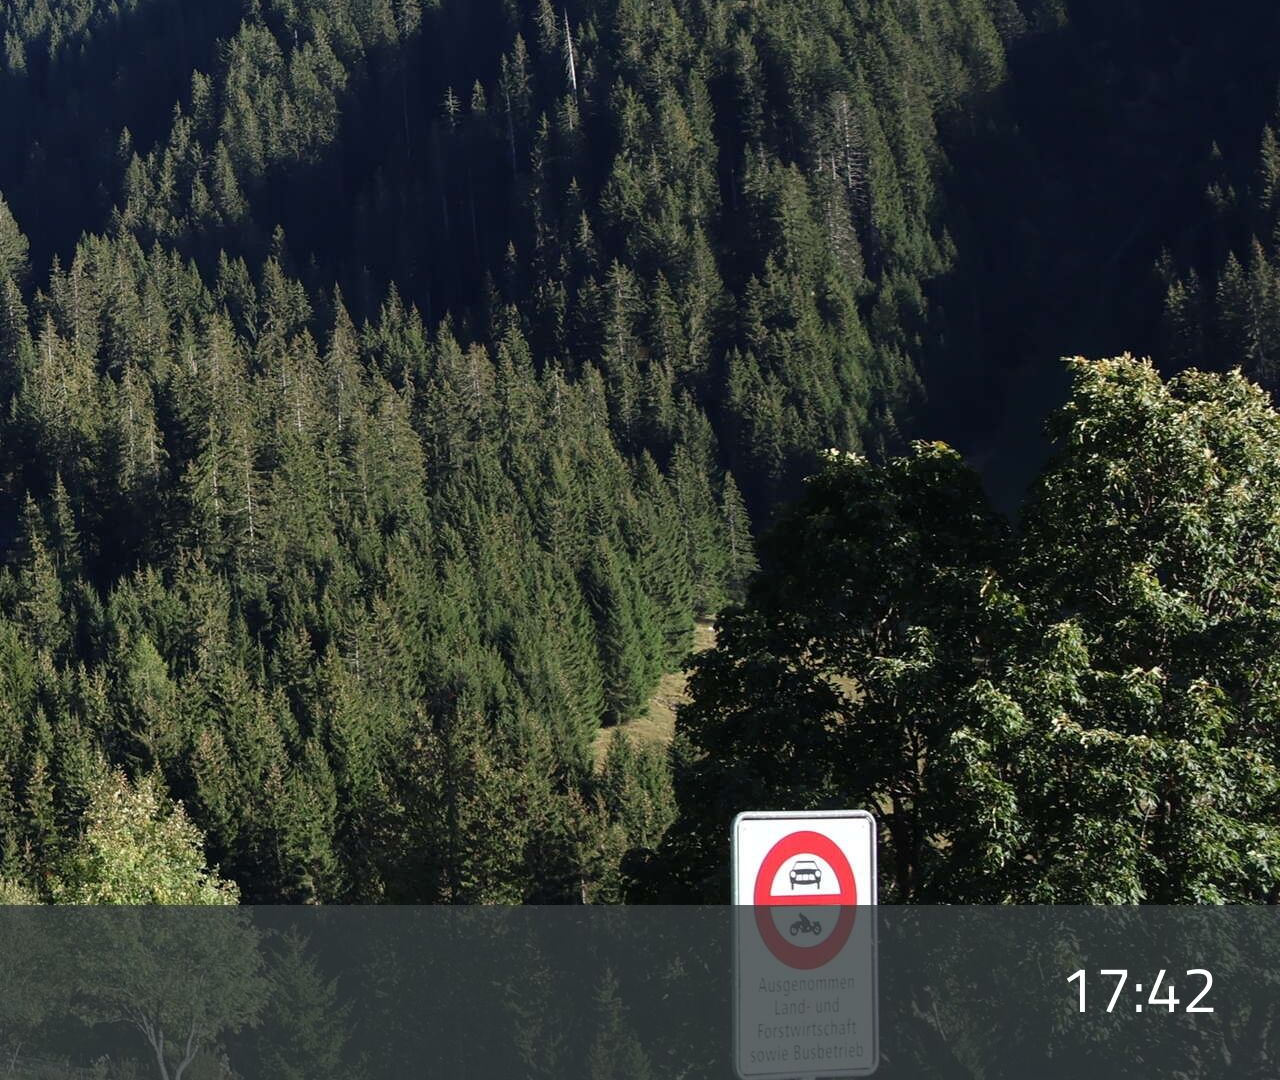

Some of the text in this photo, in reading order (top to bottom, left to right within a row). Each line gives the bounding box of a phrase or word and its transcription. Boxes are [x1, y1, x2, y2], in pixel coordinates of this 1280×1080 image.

[758, 976, 855, 996] Ausgenommen
[774, 997, 840, 1016] Land- und
[757, 1019, 857, 1039] Forstwirtschaft
[750, 1041, 864, 1063] sowie Busbetrieb
